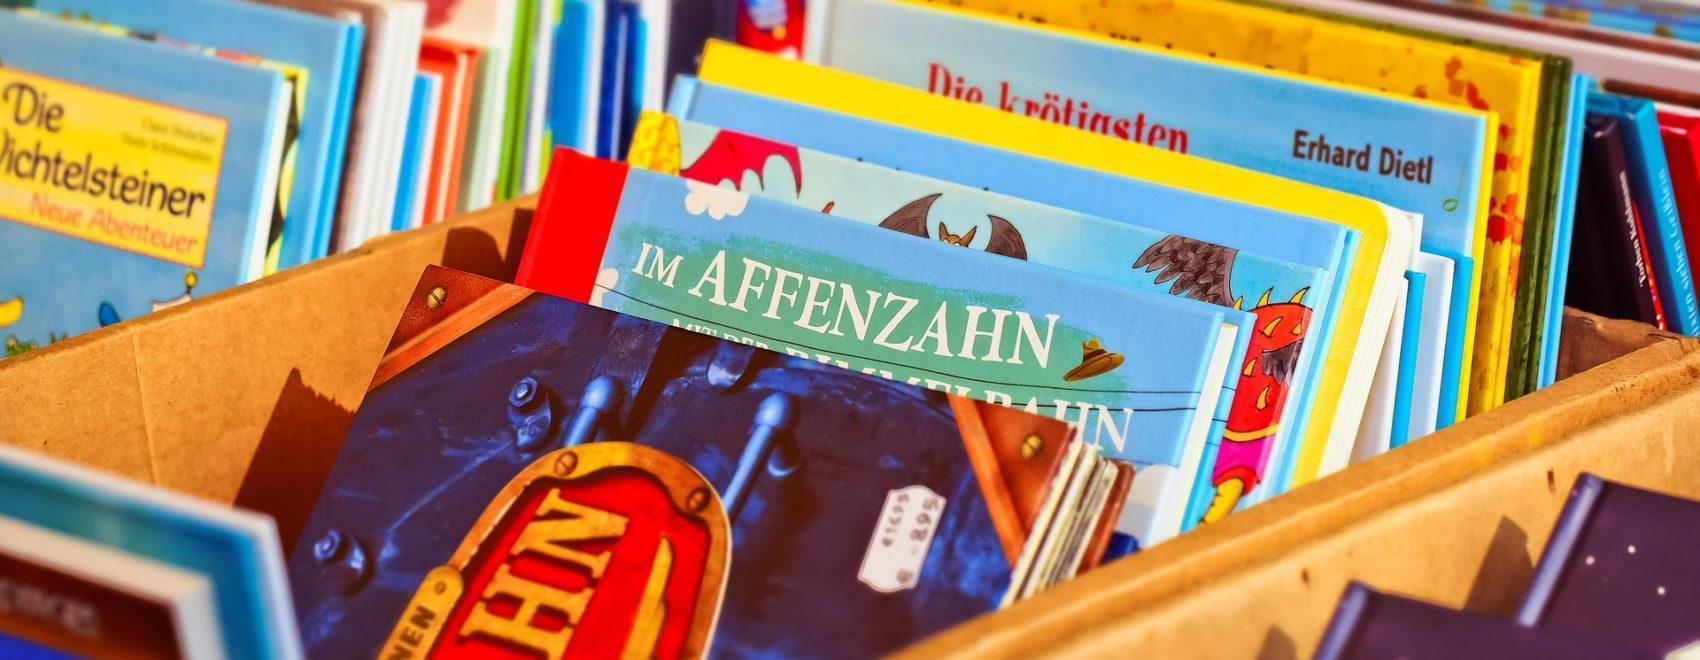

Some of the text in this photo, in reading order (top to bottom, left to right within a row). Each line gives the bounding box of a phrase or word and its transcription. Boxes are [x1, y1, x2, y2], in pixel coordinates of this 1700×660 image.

[3, 82, 65, 133] Die
[927, 62, 984, 104] Die
[0, 129, 206, 218] ichtelsteiner
[1292, 128, 1433, 185] Erhard Dietl
[31, 193, 199, 254] Neue Abenteuer
[631, 241, 1060, 369] IM AFFENZAHN
